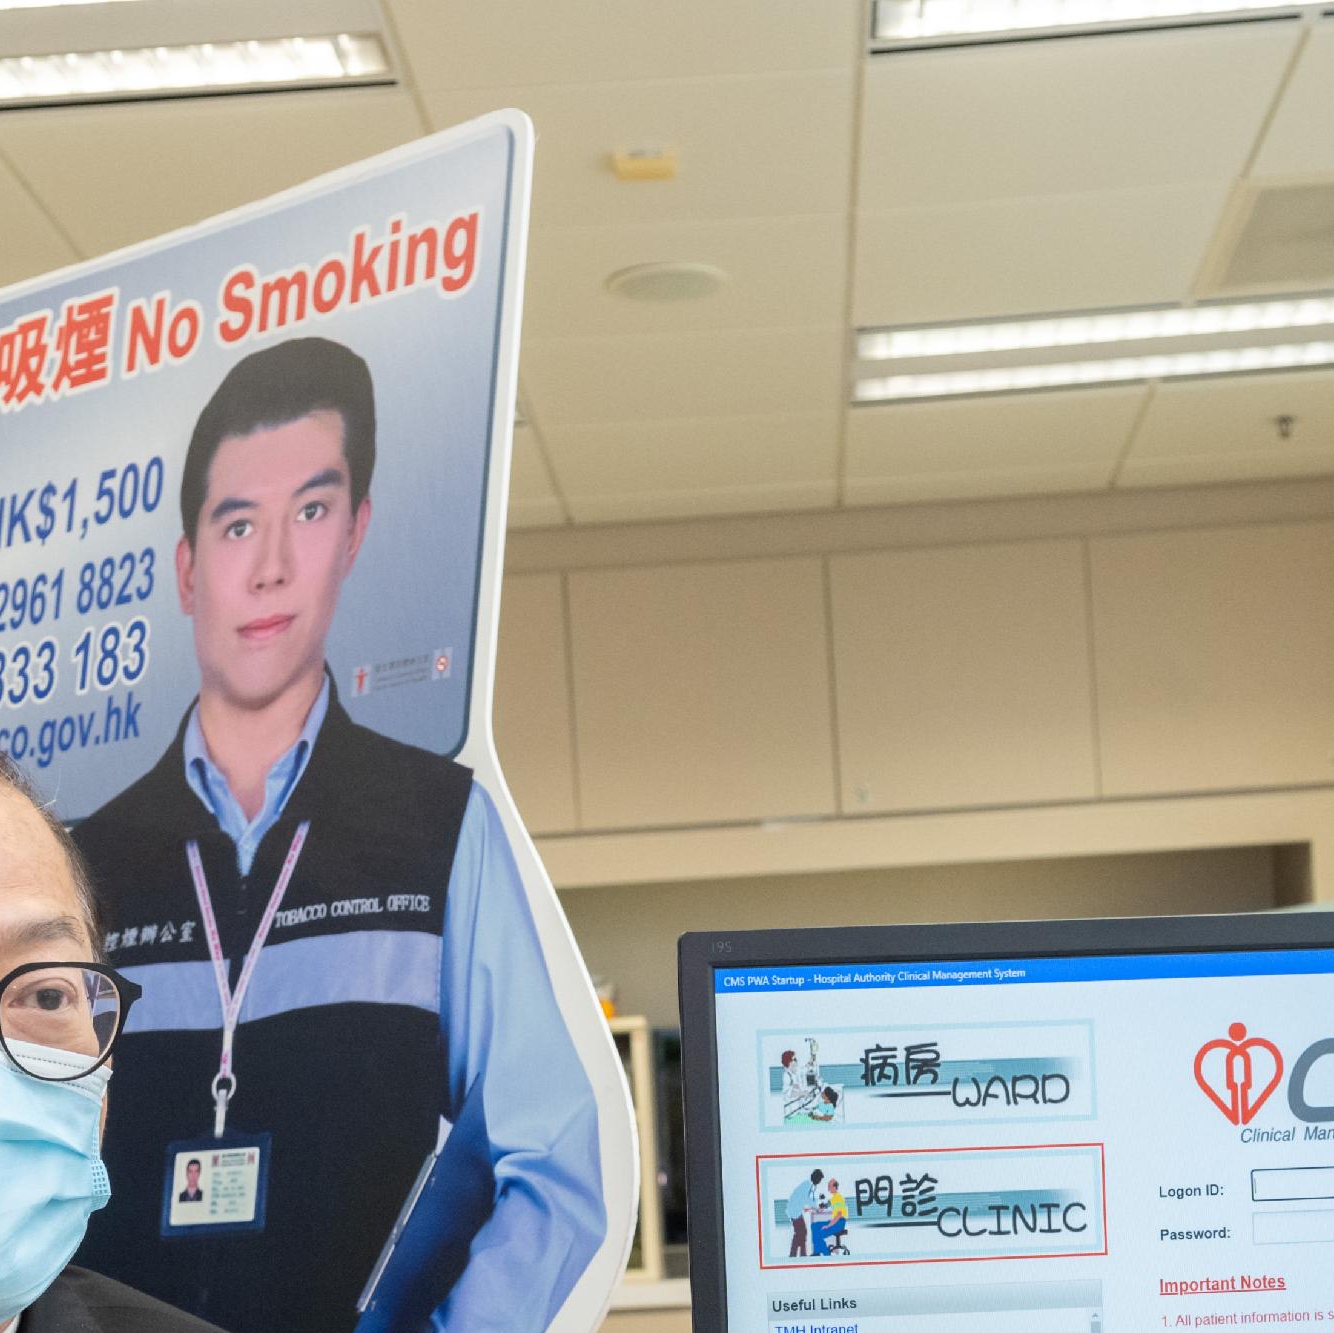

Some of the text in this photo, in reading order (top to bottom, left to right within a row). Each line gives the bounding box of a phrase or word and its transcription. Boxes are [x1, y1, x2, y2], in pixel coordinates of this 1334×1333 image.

[125, 298, 199, 371] No
[219, 212, 479, 342] Smoking
[76, 547, 155, 615] 8823
[73, 620, 148, 691] 183
[275, 902, 327, 928] TOBACCO
[330, 897, 383, 917] CONTROL
[388, 895, 430, 912] OFFICE
[724, 967, 1026, 987] CMS PWA Startup Hospital Authority Clinical Management System
[859, 1041, 1070, 1107] 病房 WARD
[1241, 1126, 1295, 1144] Clinical
[1159, 1184, 1224, 1200] Logon ID:
[855, 1173, 1087, 1238] 門診 CLINIC
[1160, 1226, 1231, 1242] Password:
[1160, 1274, 1285, 1295] Important Notes
[772, 1297, 857, 1313] Useful Links
[1162, 1316, 1171, 1328] 1.
[1175, 1314, 1191, 1327] All
[1195, 1312, 1237, 1328] patient
[1240, 1309, 1310, 1324] information
[1314, 1309, 1324, 1321] is
